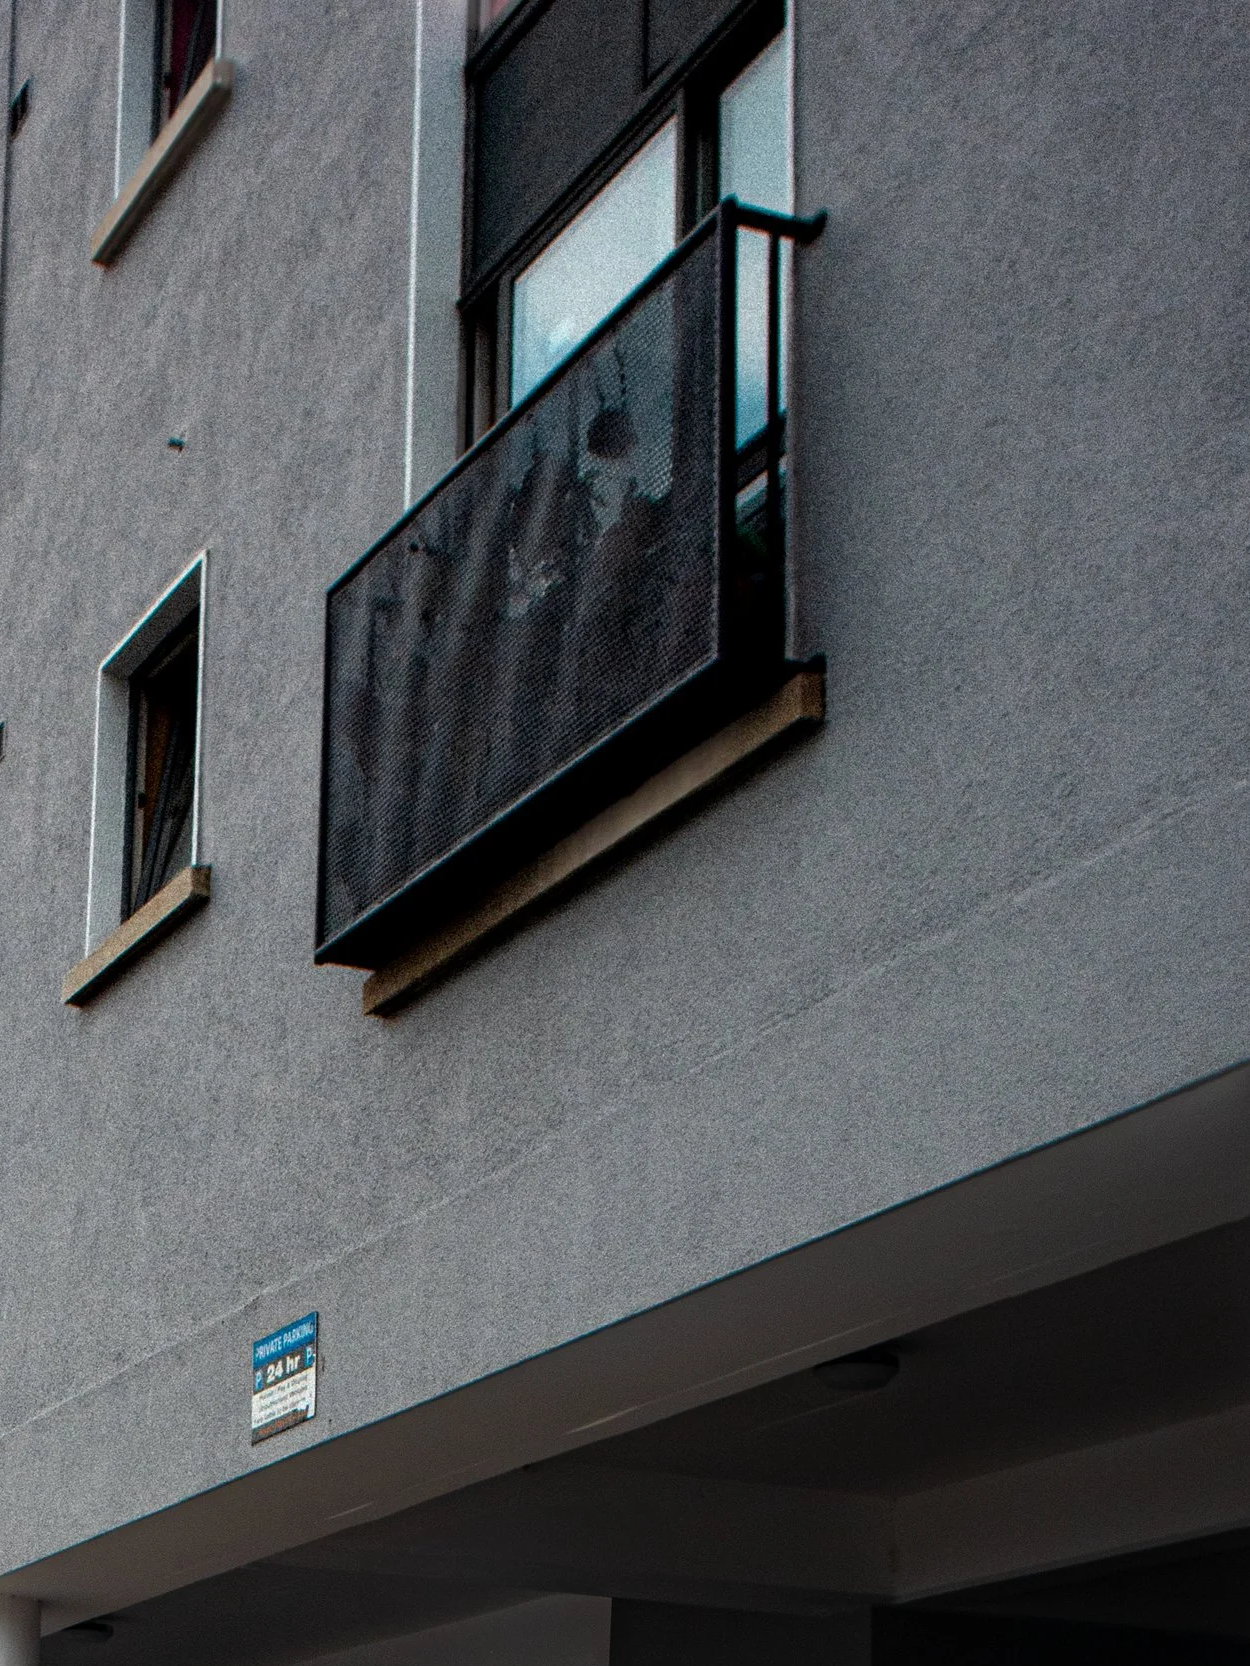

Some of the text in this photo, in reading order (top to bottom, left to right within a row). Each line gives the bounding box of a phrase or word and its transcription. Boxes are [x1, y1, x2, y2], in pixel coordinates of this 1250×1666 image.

[255, 1321, 314, 1360] PRIVATE PARKING
[266, 1360, 284, 1384] 24
